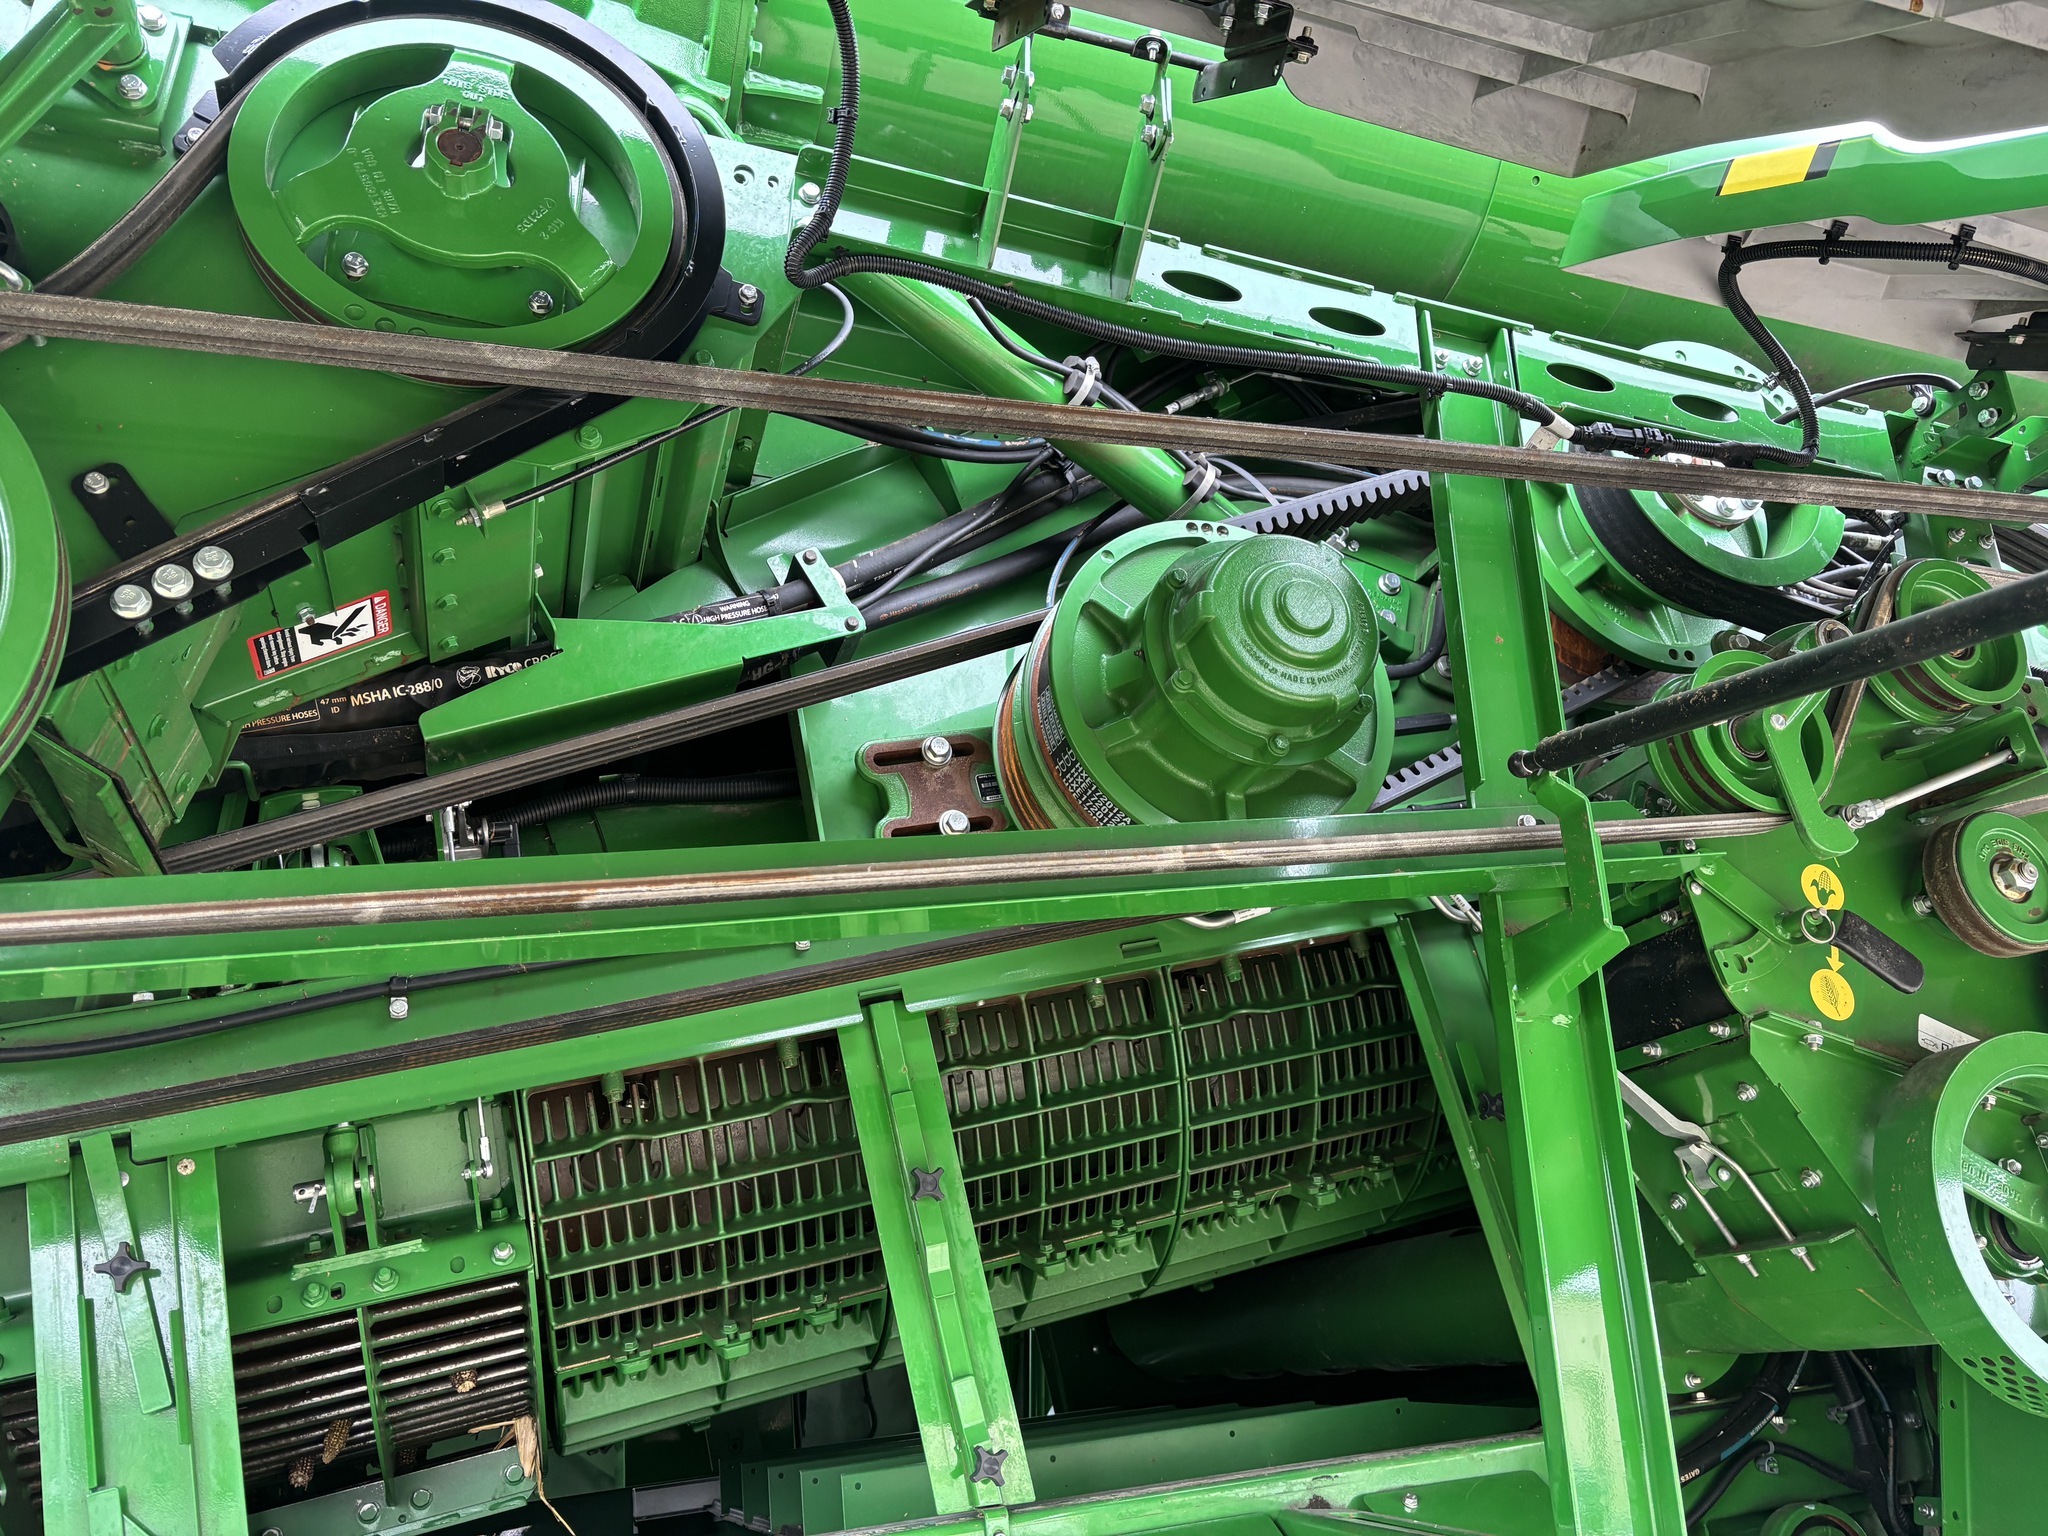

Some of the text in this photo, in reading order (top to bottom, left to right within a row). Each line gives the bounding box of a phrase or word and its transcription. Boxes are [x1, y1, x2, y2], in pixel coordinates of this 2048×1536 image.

[719, 600, 751, 612] WARNING
[374, 602, 390, 635] DANGER
[703, 614, 720, 623] HIGH
[720, 609, 752, 621] PRESSURE
[485, 662, 522, 678] RYCO
[1281, 671, 1305, 684] MADE
[1318, 665, 1351, 685] PORTUGAL
[350, 677, 443, 706] MSHA IC-288/0
[251, 714, 292, 727] PRESSURE
[292, 709, 318, 721] HOSES
[331, 706, 340, 714] ID
[1075, 762, 1132, 825] HXE172012A
[1990, 838, 2010, 848] SIDE
[1979, 844, 1991, 862] OUT
[1680, 1468, 1700, 1483] GATES
